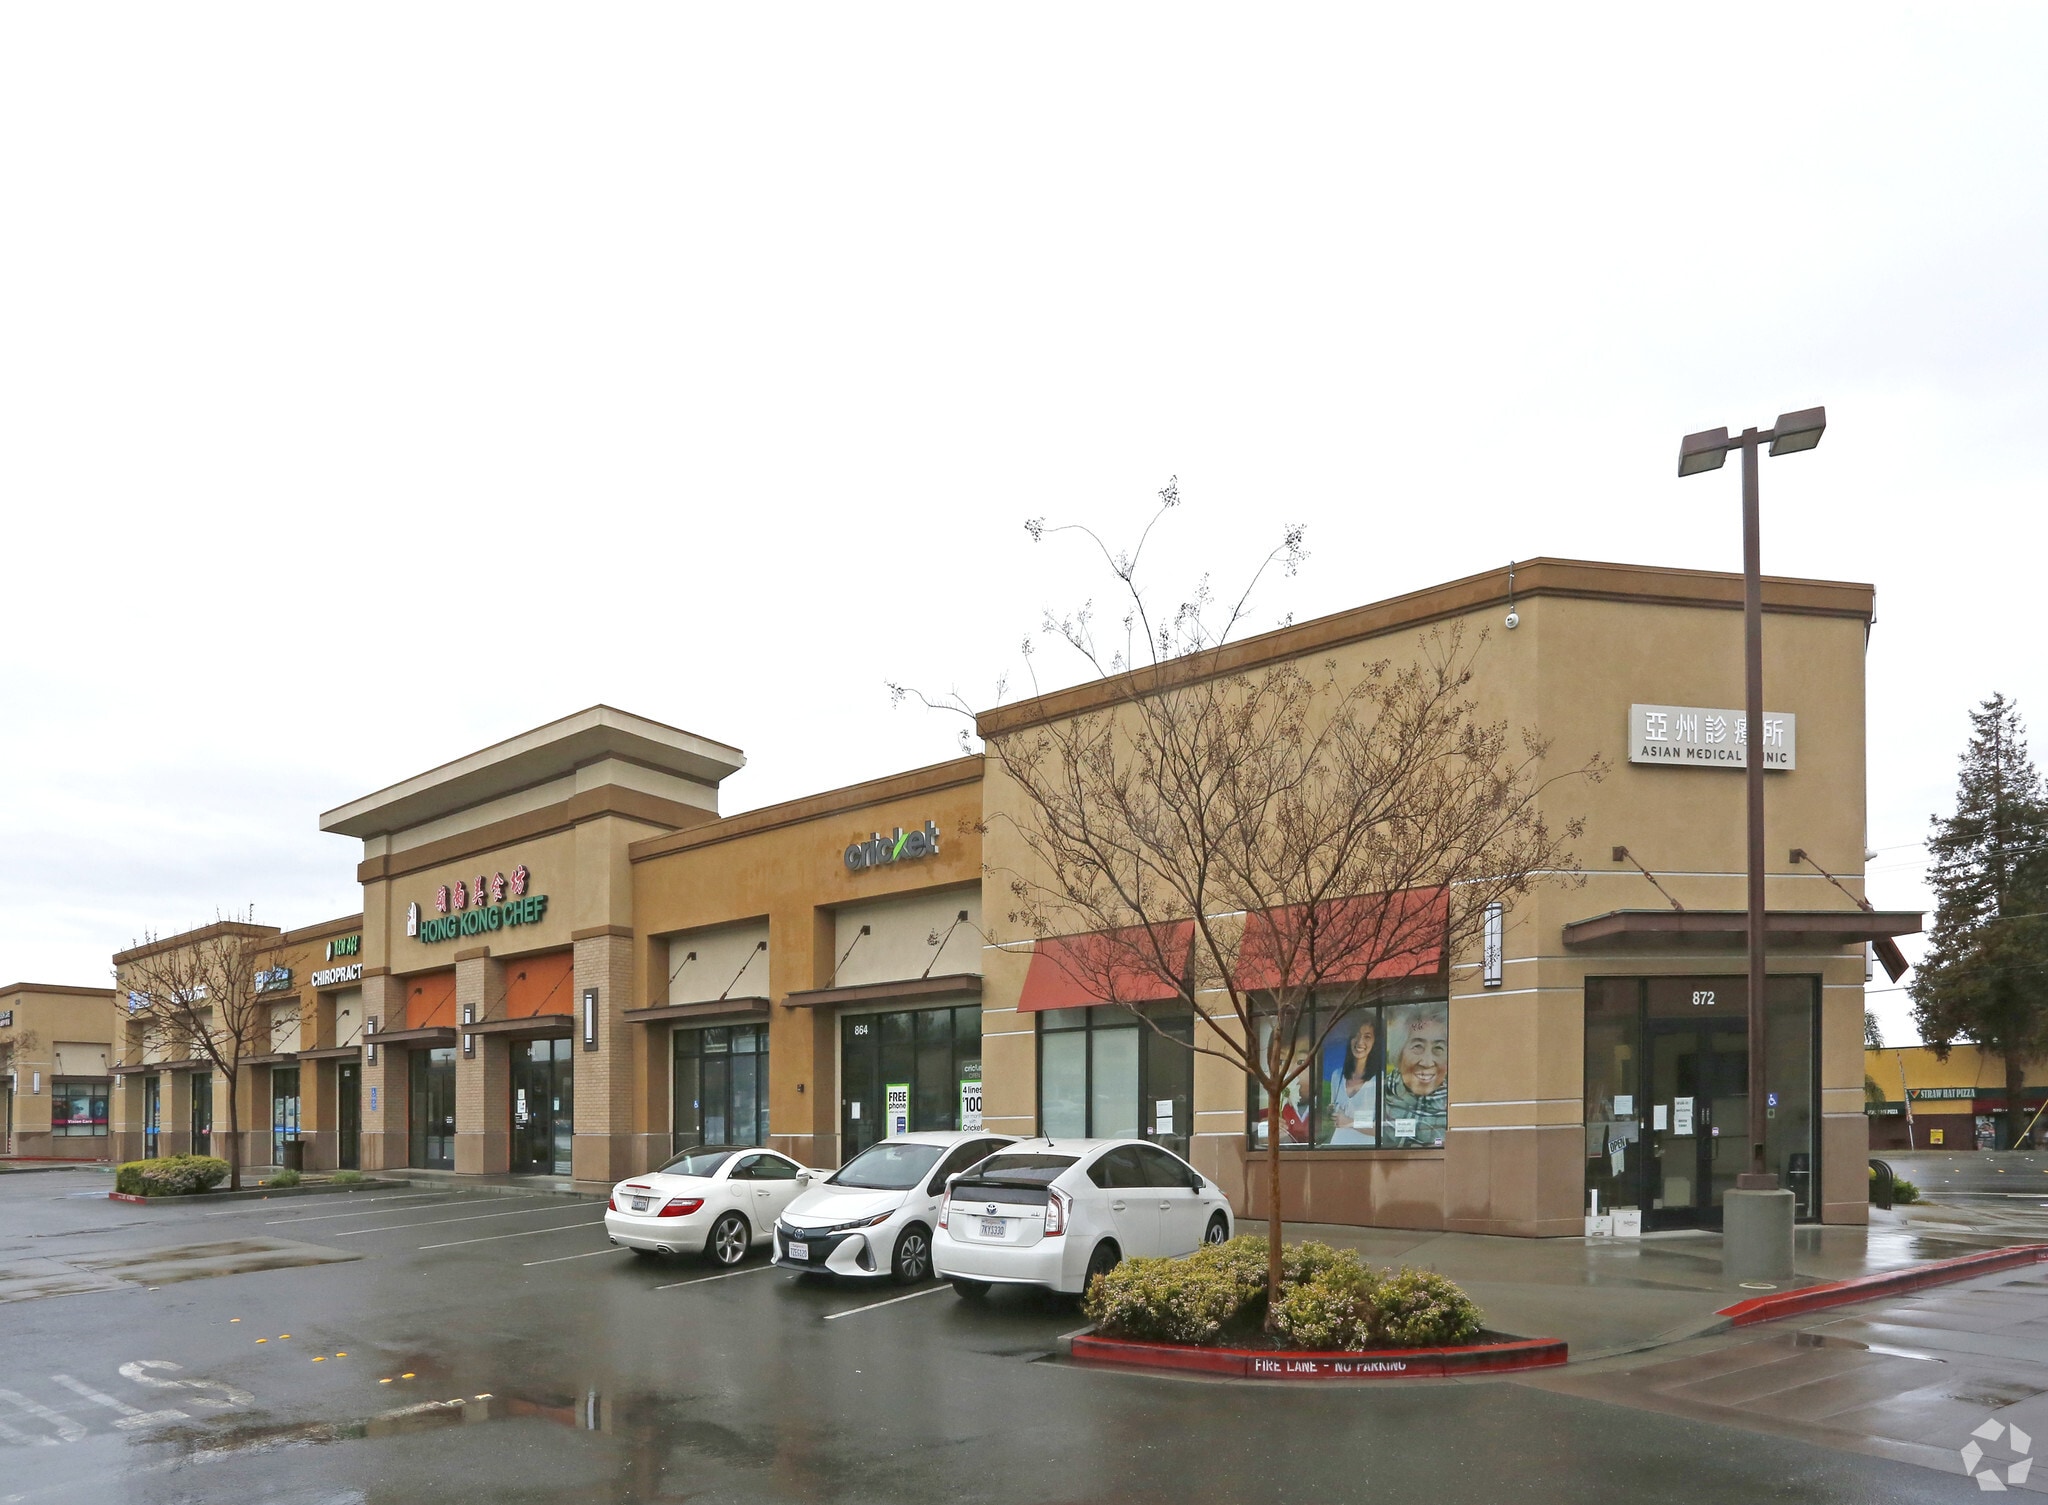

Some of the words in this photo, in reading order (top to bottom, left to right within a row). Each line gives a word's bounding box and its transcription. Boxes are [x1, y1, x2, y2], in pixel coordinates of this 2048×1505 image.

[1641, 745, 1681, 758] ASIAN
[1686, 747, 1742, 761] MEDICAL
[844, 820, 938, 871] cricket
[420, 915, 456, 943] HONG
[460, 905, 499, 935] KONG
[502, 895, 545, 926] CHEF
[311, 963, 362, 987] CHIROPRACT
[1692, 991, 1715, 1005] 872
[854, 1025, 868, 1035] 864
[889, 1091, 906, 1101] FREE
[1920, 1089, 1942, 1098] STRAW
[1943, 1089, 1955, 1098] HAT
[1956, 1088, 1975, 1097] PIZZA
[889, 1102, 906, 1110] phone
[1610, 1137, 1625, 1152] OPEN
[1255, 1358, 1281, 1372] FIRE
[1286, 1360, 1318, 1372] LANE
[1334, 1361, 1352, 1372] NO
[1356, 1361, 1407, 1372] PARKING
